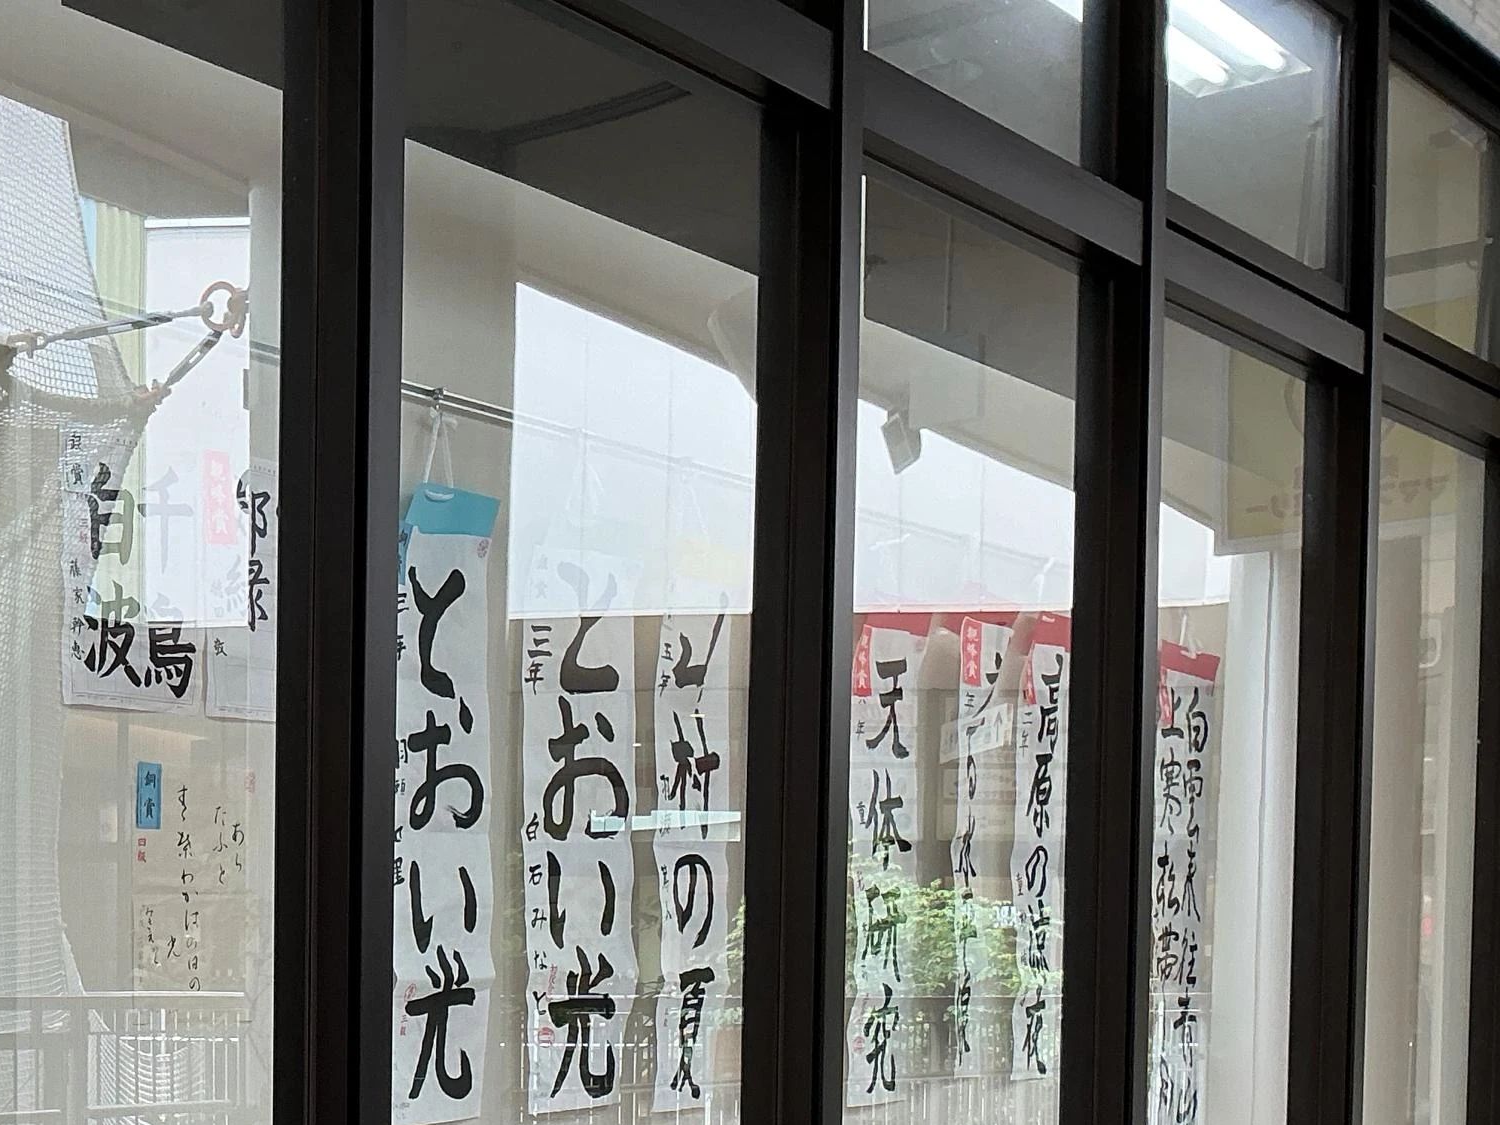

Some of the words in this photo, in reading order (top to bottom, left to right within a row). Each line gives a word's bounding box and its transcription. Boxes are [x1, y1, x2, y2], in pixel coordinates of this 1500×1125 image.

[83, 461, 143, 687] 白波
[524, 625, 553, 695] 三年
[405, 565, 485, 1099] とおい光
[525, 812, 549, 1016] 白石みなと
[543, 561, 630, 1098] とおい光
